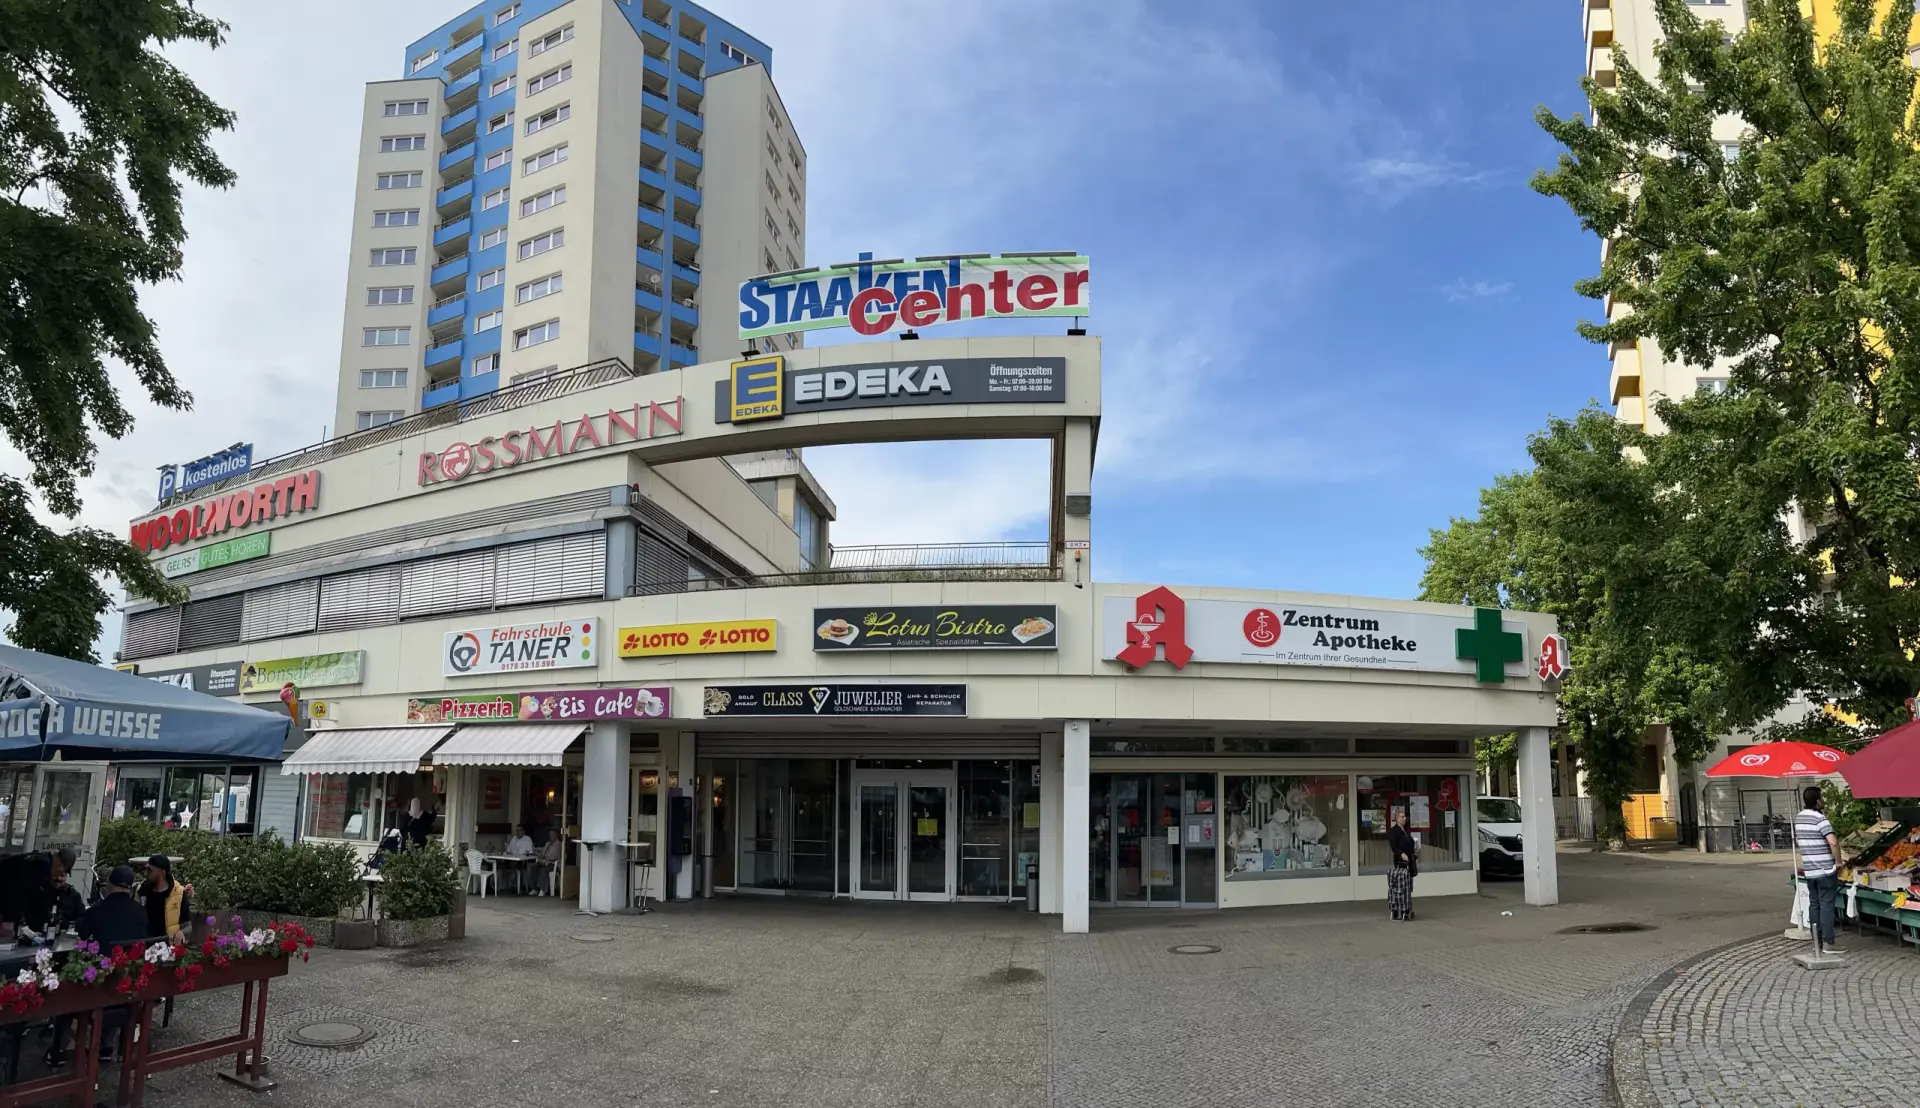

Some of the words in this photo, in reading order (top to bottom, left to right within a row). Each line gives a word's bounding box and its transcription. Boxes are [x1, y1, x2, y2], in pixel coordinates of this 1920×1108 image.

[740, 252, 961, 328] STAAKEN
[849, 269, 1089, 335] Center
[990, 364, 1052, 377] Öffnungszeiten
[795, 365, 952, 403] EDEKA
[736, 404, 779, 417] EDEKA
[418, 395, 683, 486] ROSSMANN
[186, 454, 248, 486] kostenlos
[161, 474, 173, 499] P
[131, 469, 320, 553] WOOLWORTH
[202, 546, 230, 564] GUTES
[491, 621, 572, 642] Fahrschule
[866, 612, 932, 637] Lotus
[936, 611, 1007, 636] Bistro
[1282, 610, 1379, 631] Zentrum
[489, 636, 571, 664] TANER
[642, 632, 689, 649] LOTTO
[719, 628, 770, 645] LOTTO
[1313, 631, 1417, 651] Apotheke
[1276, 652, 1286, 660] Im
[1288, 652, 1321, 661] Zentrum
[1324, 654, 1341, 662] Ihrer
[1343, 655, 1387, 664] Gesundheit
[257, 661, 308, 684] Bonsai
[440, 696, 514, 719] Pizzeria
[559, 697, 586, 718] Eis
[594, 691, 633, 717] Cafe
[763, 692, 803, 706] CLASS
[834, 691, 903, 706] JUWELIER
[72, 706, 162, 740] WEISSE
